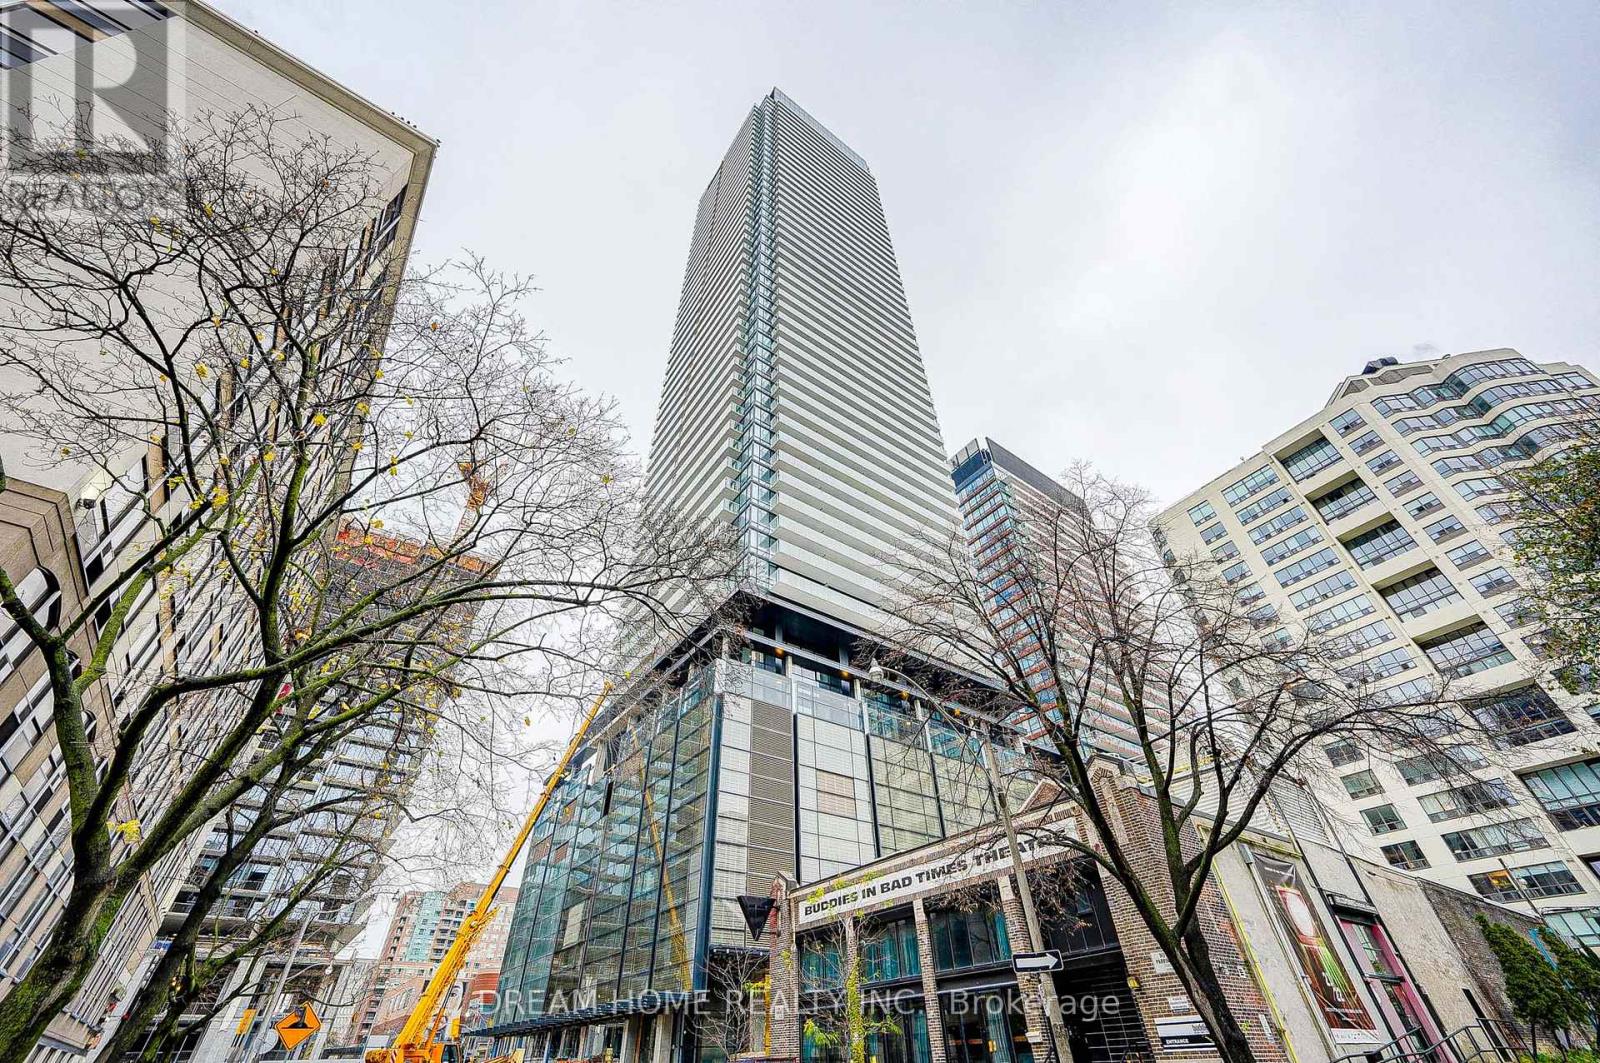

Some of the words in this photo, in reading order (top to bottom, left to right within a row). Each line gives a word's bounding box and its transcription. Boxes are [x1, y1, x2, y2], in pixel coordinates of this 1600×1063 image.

[804, 891, 859, 916] BUDDIES
[861, 886, 877, 899] IN
[880, 876, 913, 894] BAD
[915, 859, 968, 883] TIMES
